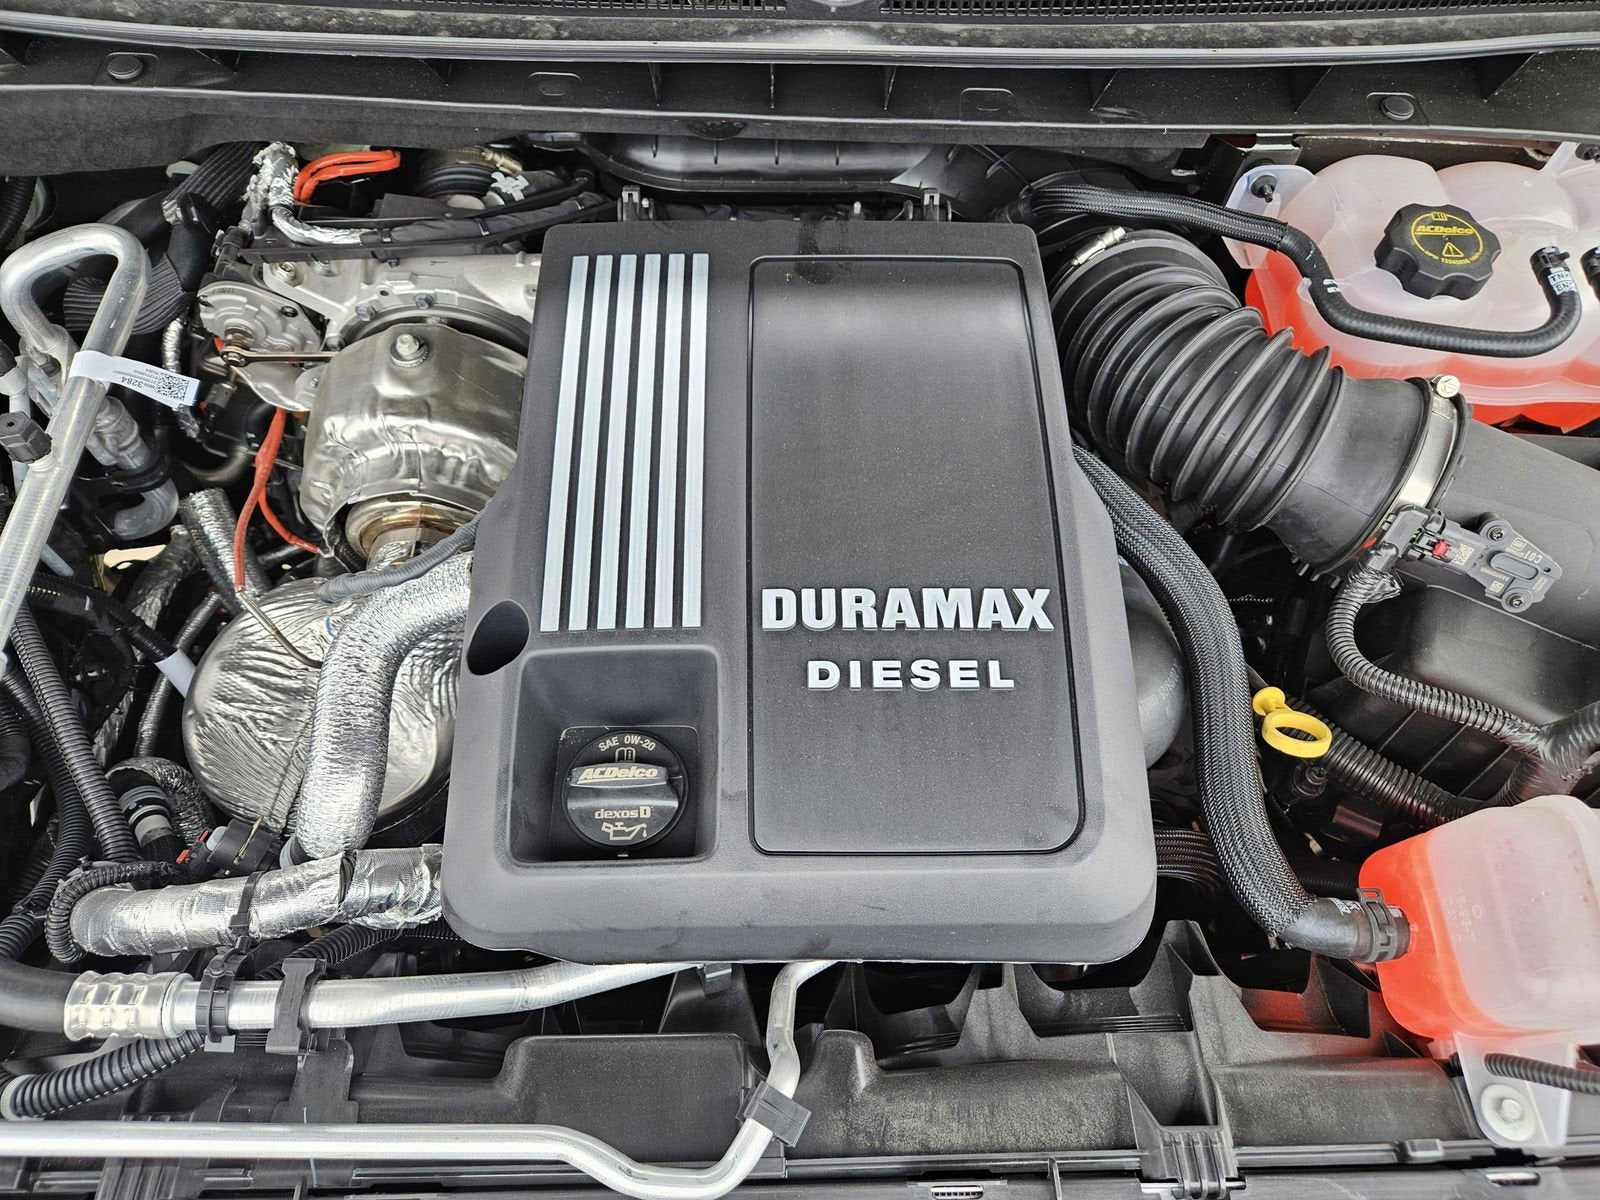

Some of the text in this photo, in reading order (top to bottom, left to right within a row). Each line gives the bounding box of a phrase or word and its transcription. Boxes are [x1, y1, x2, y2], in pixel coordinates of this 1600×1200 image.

[1416, 225, 1474, 234] ACDelco
[121, 376, 144, 389] 3284
[761, 587, 1055, 632] DURAMAX
[807, 659, 1015, 692] DIESEL
[598, 734, 657, 752] SAE 0W-20
[578, 765, 659, 780] ACDelco
